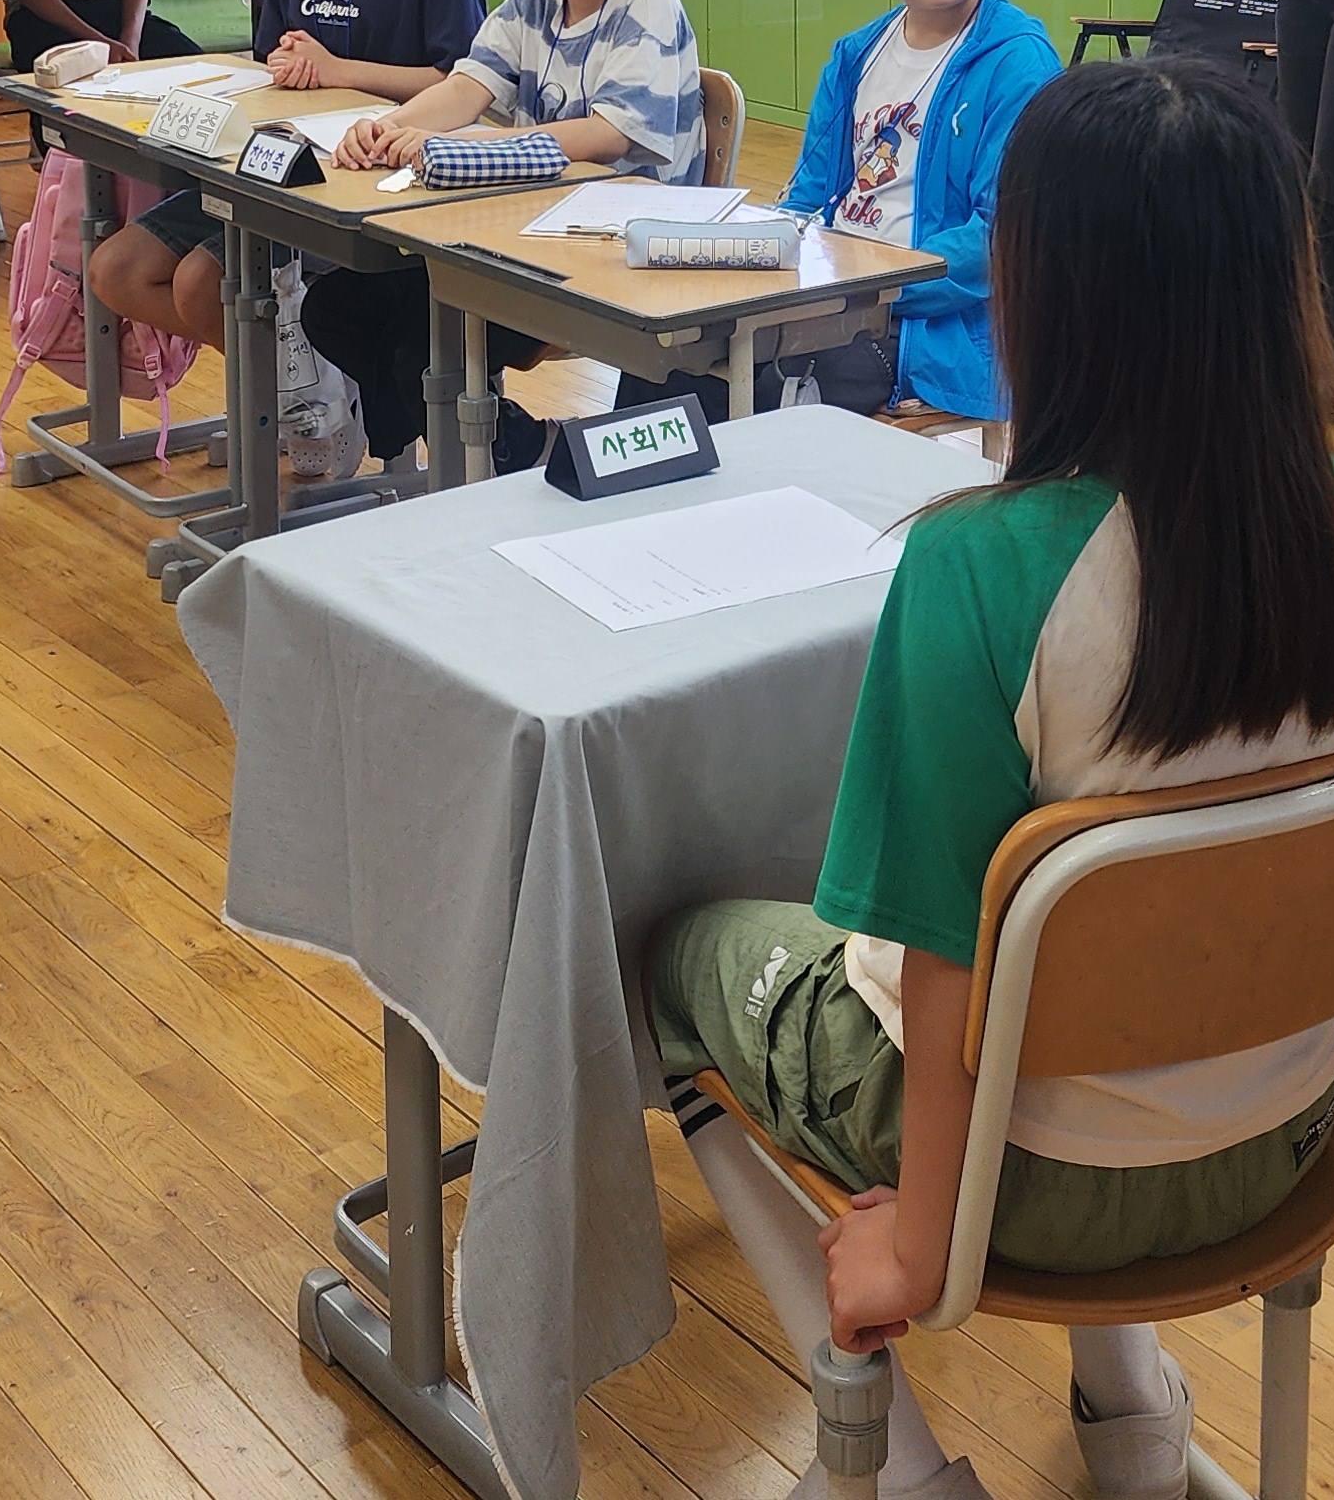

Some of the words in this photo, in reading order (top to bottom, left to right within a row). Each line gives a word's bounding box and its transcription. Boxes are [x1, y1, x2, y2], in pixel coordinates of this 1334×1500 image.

[158, 101, 220, 149] 찬성측
[248, 143, 285, 175] 찬성측
[602, 416, 687, 461] 사회자
